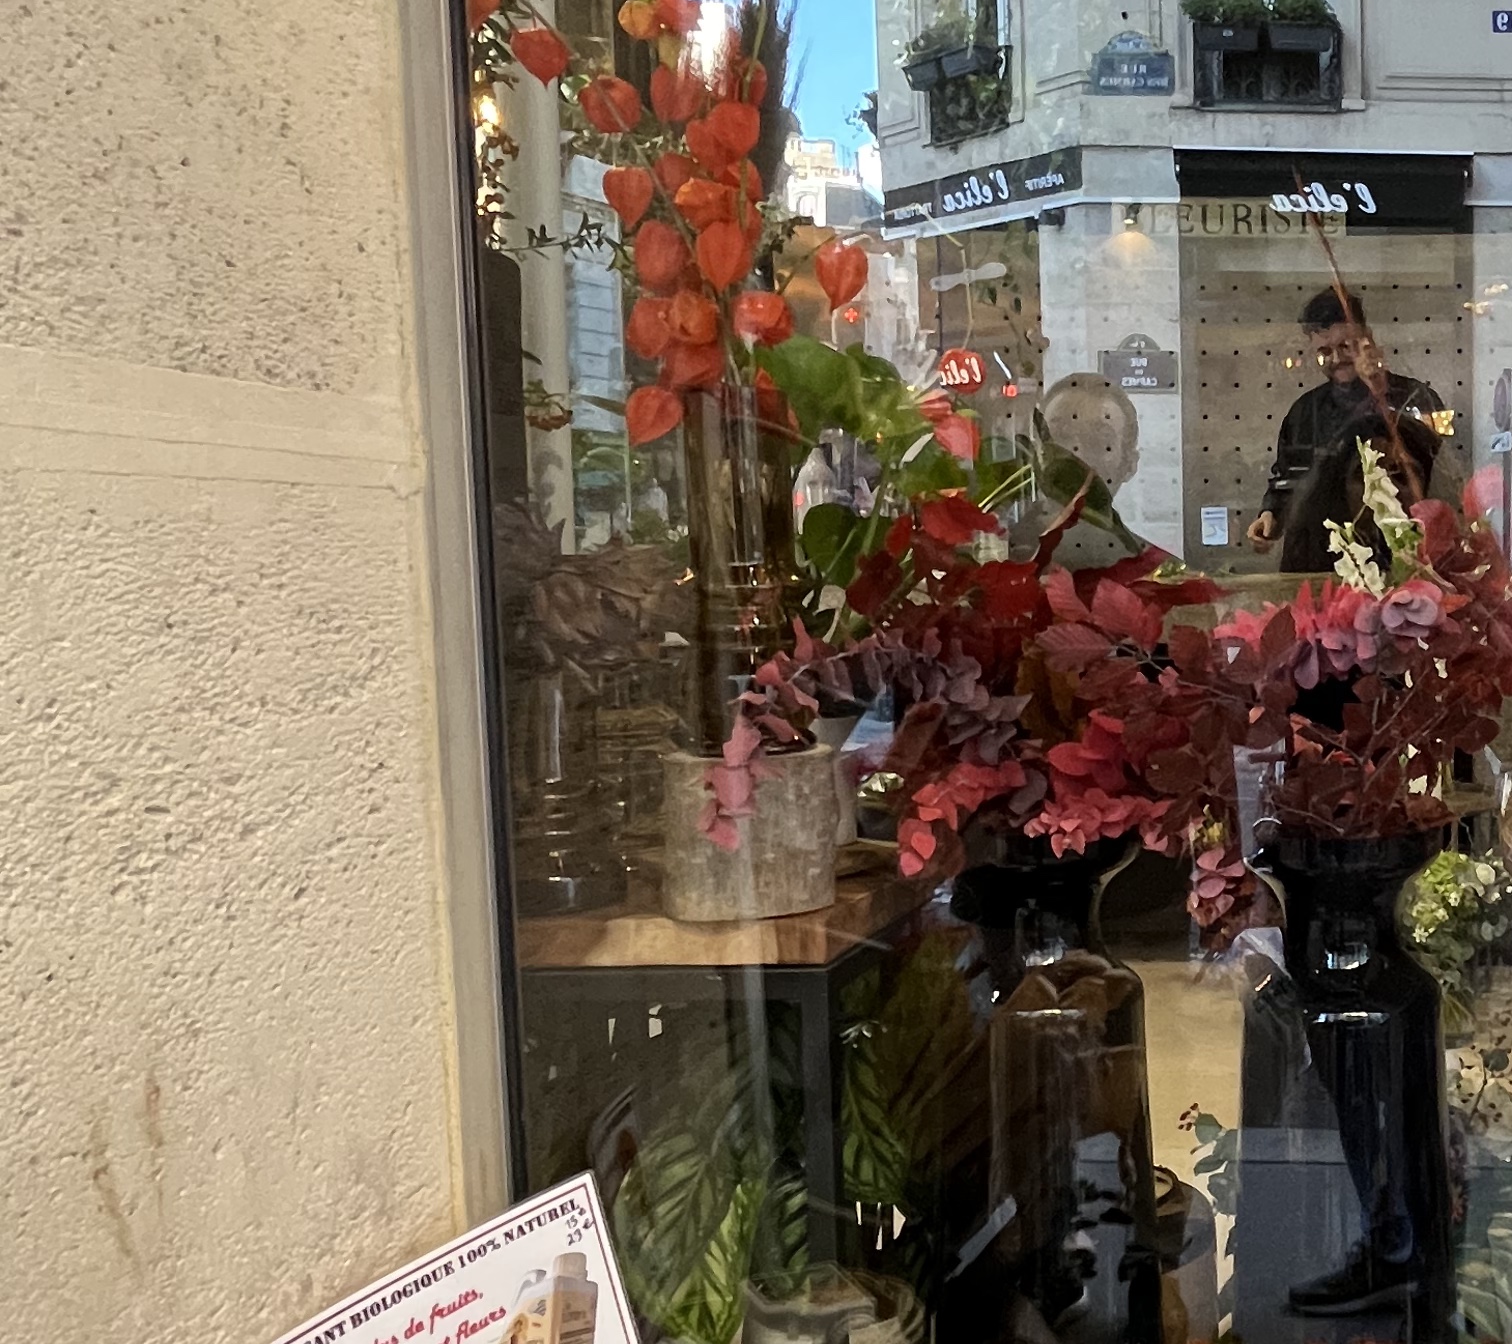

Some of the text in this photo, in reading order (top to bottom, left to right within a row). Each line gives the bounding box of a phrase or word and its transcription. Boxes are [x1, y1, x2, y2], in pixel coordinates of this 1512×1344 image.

[349, 1260, 456, 1329] BIOLOGIQUE
[458, 1237, 501, 1269] 100%
[503, 1198, 581, 1245] NATUREL
[404, 1317, 425, 1340] de
[429, 1288, 483, 1335] fruits,
